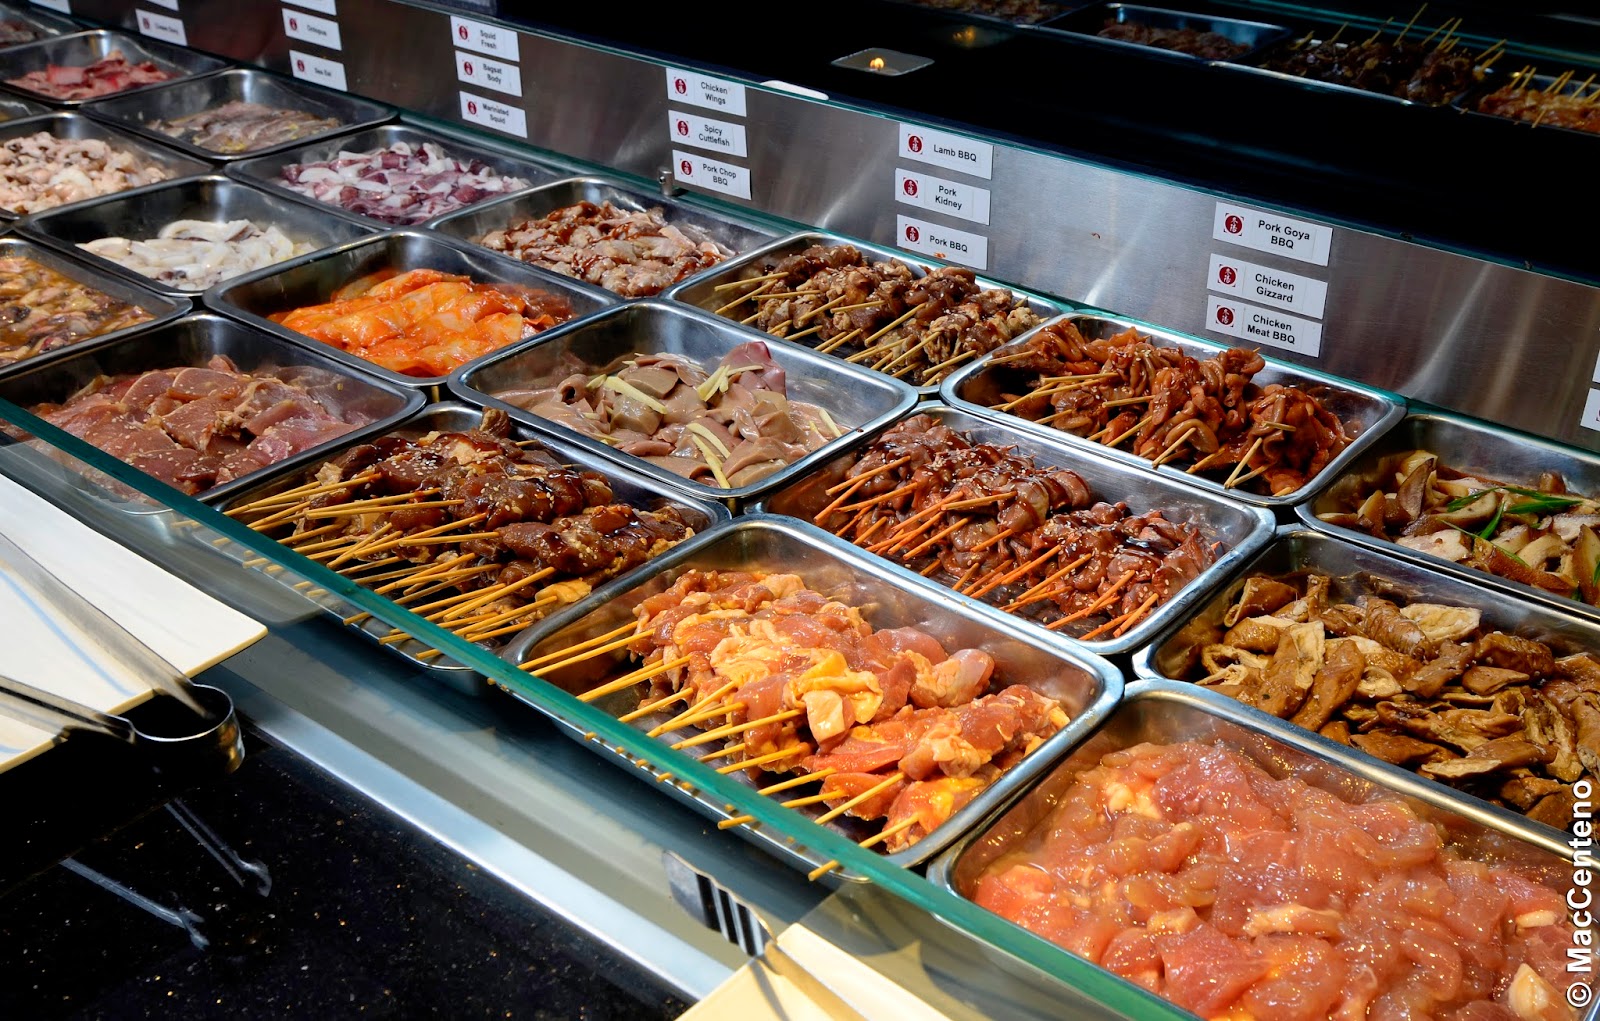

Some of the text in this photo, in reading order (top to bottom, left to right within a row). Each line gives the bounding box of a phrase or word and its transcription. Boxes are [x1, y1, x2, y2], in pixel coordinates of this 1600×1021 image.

[480, 29, 496, 40] Squid
[481, 39, 497, 49] Fresh
[487, 73, 501, 84] Body
[701, 81, 728, 94] Chicken
[705, 92, 726, 105] Wings
[489, 114, 505, 124] Squid
[704, 124, 723, 136] Spicy
[698, 133, 730, 146] Cuttlefish
[933, 144, 956, 157] Lamb
[958, 150, 977, 162] BBQ
[702, 163, 718, 173] Pork
[719, 167, 737, 179] Chop
[712, 175, 728, 186] BBQ
[938, 185, 957, 196] Pork
[935, 195, 962, 210] Kidney
[1258, 219, 1281, 233] Pork
[1284, 226, 1310, 240] Goya
[929, 235, 968, 253] Pork BBQ
[1270, 235, 1294, 249] BBQ
[1255, 273, 1295, 291] Chicken
[1256, 286, 1293, 303] Gizzard
[1252, 314, 1292, 331] Chicken
[1247, 324, 1295, 344] Meat BBQ
